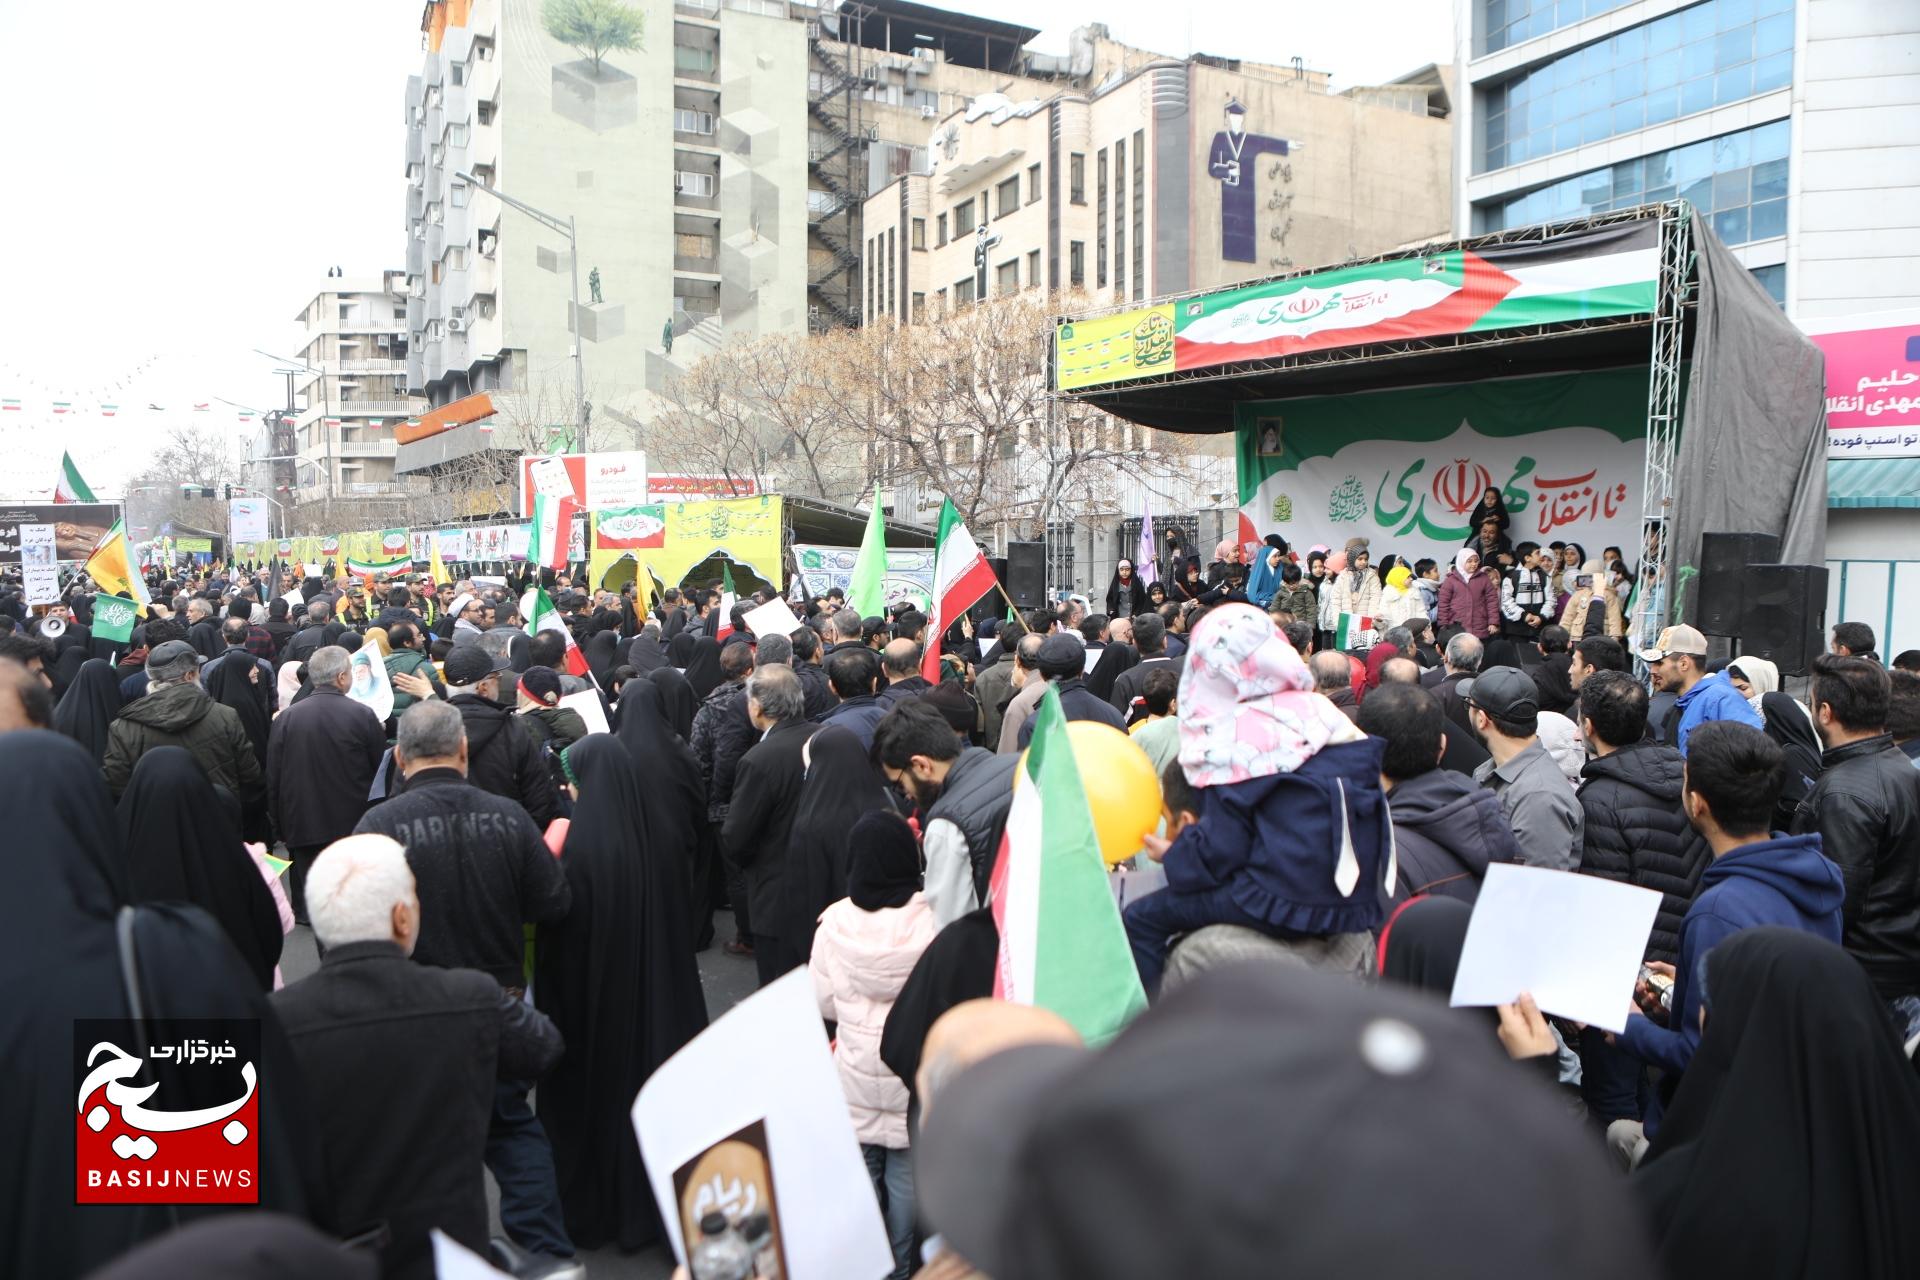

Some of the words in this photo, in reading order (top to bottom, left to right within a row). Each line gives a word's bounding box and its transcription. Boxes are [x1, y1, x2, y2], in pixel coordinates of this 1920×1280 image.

[1256, 292, 1343, 326] مهدی
[1856, 369, 1919, 393] حلیم
[1373, 455, 1537, 542] مهدی
[1533, 468, 1600, 535] انقلاب
[1603, 482, 1627, 519] تا
[395, 812, 519, 848] DARKNESS
